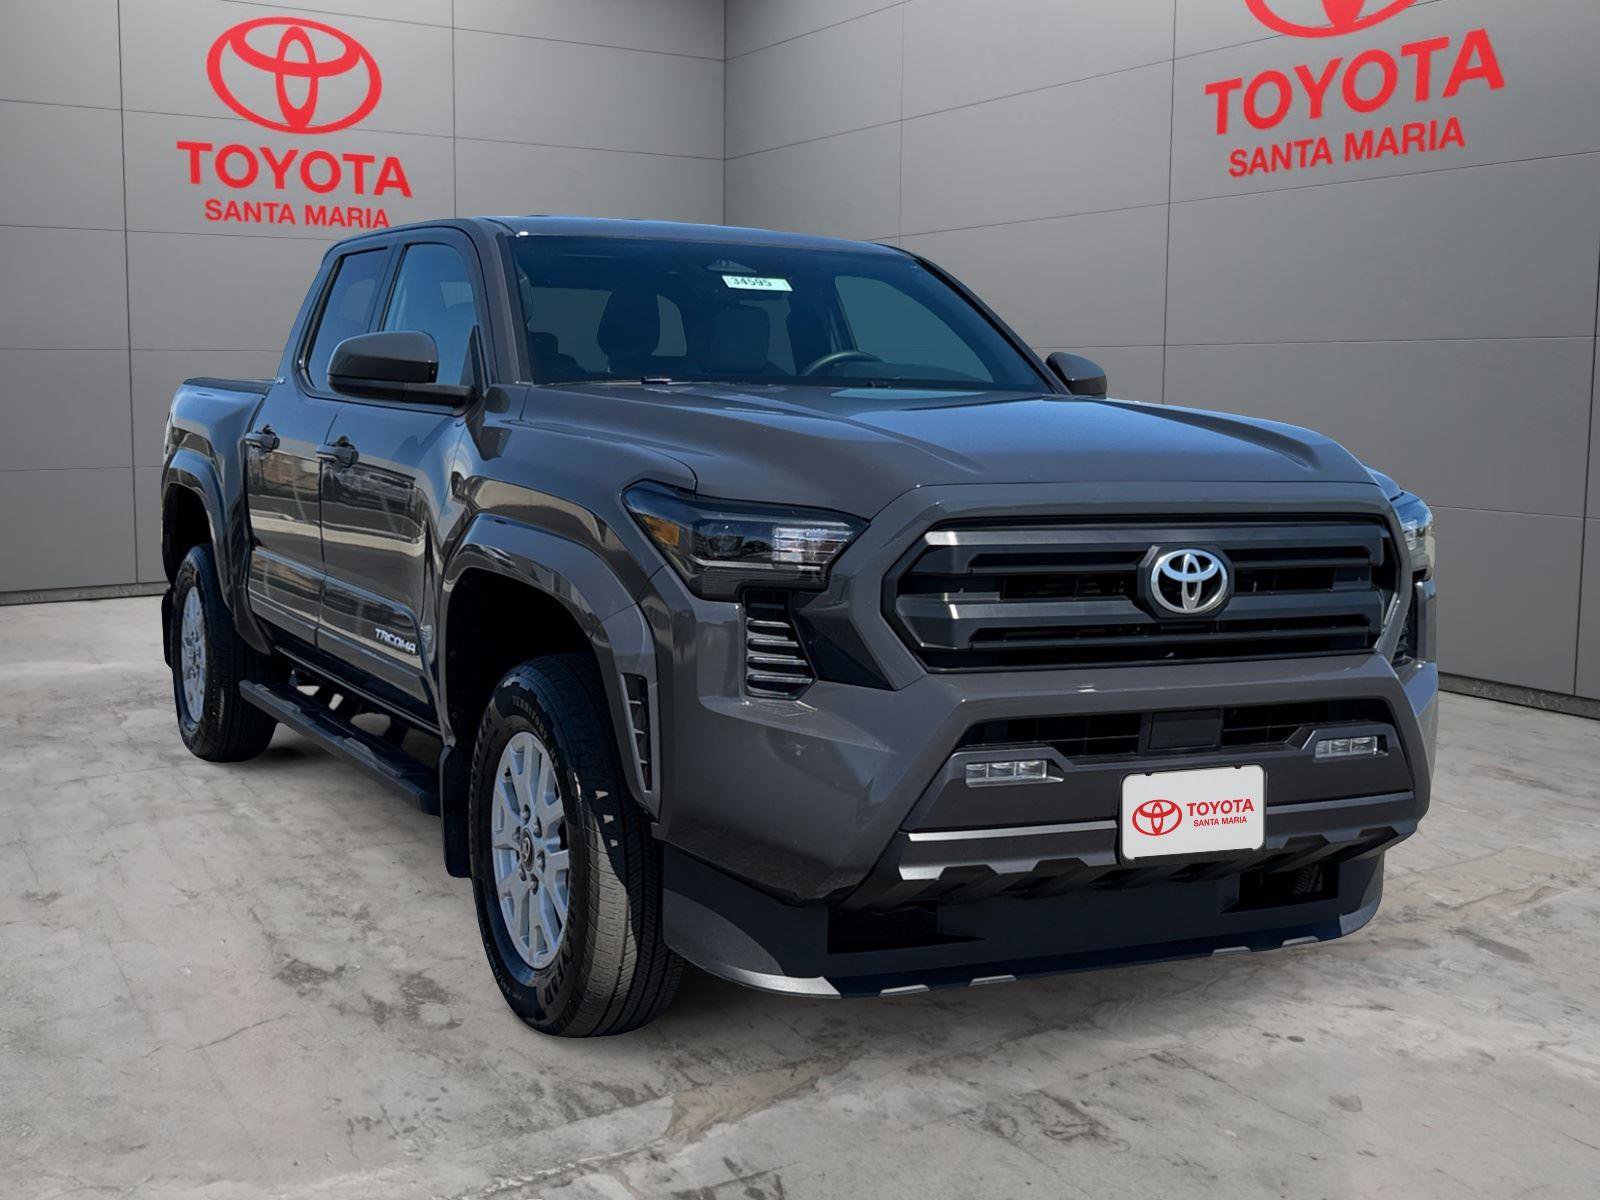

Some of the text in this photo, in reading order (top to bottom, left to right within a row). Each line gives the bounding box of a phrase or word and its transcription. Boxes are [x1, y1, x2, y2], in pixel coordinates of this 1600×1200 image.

[1203, 27, 1506, 136] TOYOTA
[1228, 115, 1466, 179] SANTA MARIA
[176, 140, 413, 199] TOYOTA
[204, 198, 390, 229] SANTA MARIA
[732, 277, 772, 287] 34595
[375, 627, 416, 654] TACOMA
[1186, 798, 1255, 817] TOYOTA
[1193, 815, 1247, 828] SANTA MARIA
